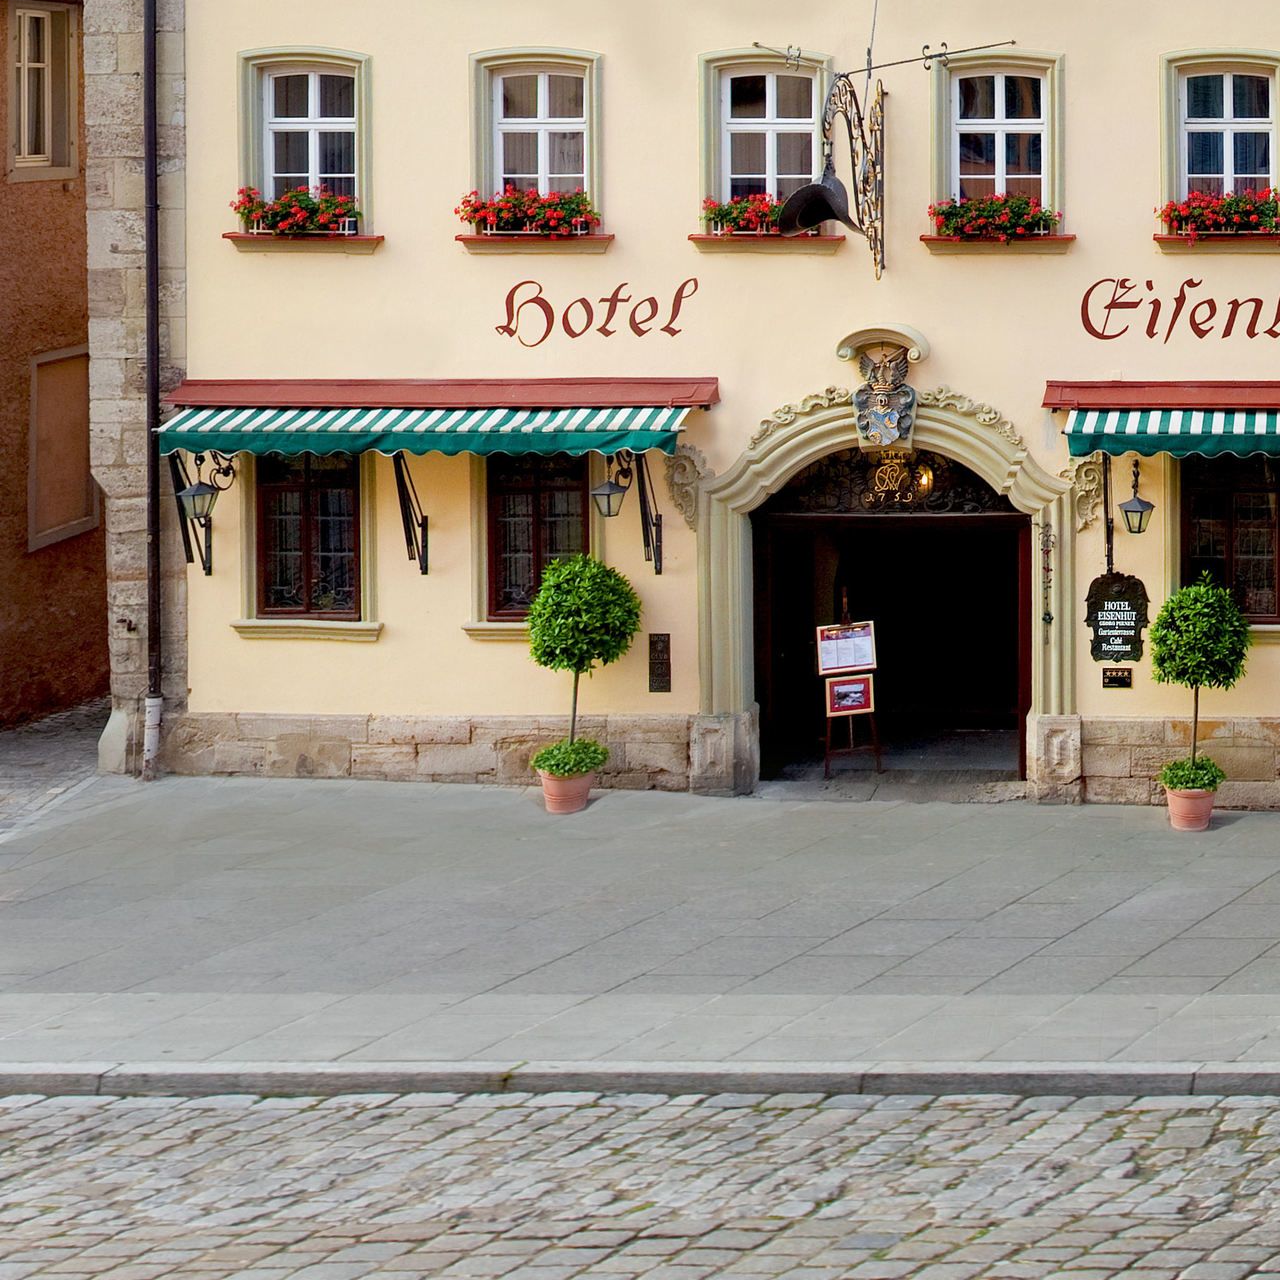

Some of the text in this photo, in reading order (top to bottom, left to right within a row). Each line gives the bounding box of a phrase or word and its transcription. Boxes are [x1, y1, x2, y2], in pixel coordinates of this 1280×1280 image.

[495, 277, 698, 348] Hotel
[1104, 601, 1131, 611] HOTEL
[1097, 611, 1137, 621] EISENHUT
[1101, 643, 1131, 651] Restaurant
